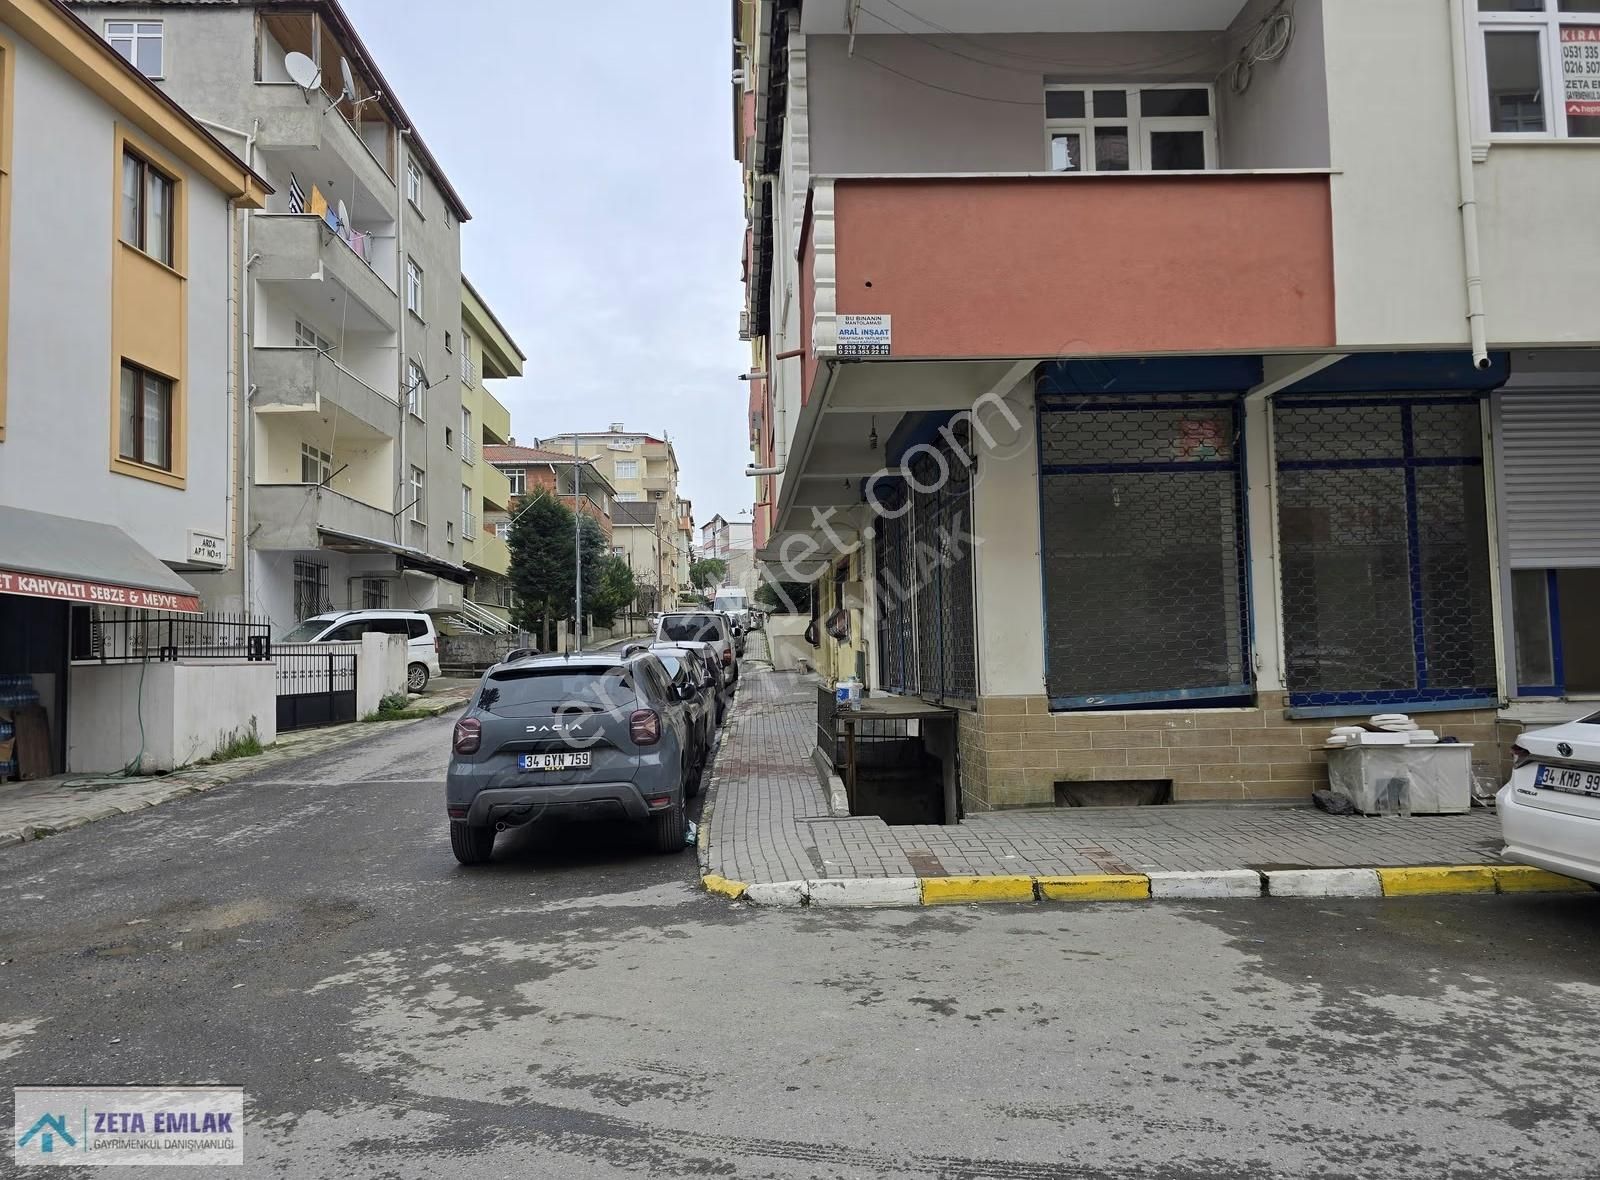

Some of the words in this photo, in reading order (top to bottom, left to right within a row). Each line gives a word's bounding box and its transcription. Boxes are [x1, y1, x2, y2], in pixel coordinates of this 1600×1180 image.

[1563, 46, 1582, 59] 0531
[1584, 46, 1599, 59] 335
[1564, 61, 1583, 74] 0216
[1565, 80, 1590, 89] ZETA
[839, 328, 859, 336] ARAL
[202, 538, 216, 548] ARDA
[194, 547, 205, 556] APT
[18, 576, 86, 598] KAHVALTI
[90, 586, 125, 602] SEBZE
[129, 591, 138, 603] &
[143, 592, 178, 608] MEYVE
[526, 723, 582, 732] DACIA
[526, 755, 539, 767] 34
[544, 754, 565, 767] GYN
[568, 752, 589, 765] 759
[1542, 768, 1555, 784] 34
[1560, 770, 1581, 788] KMB
